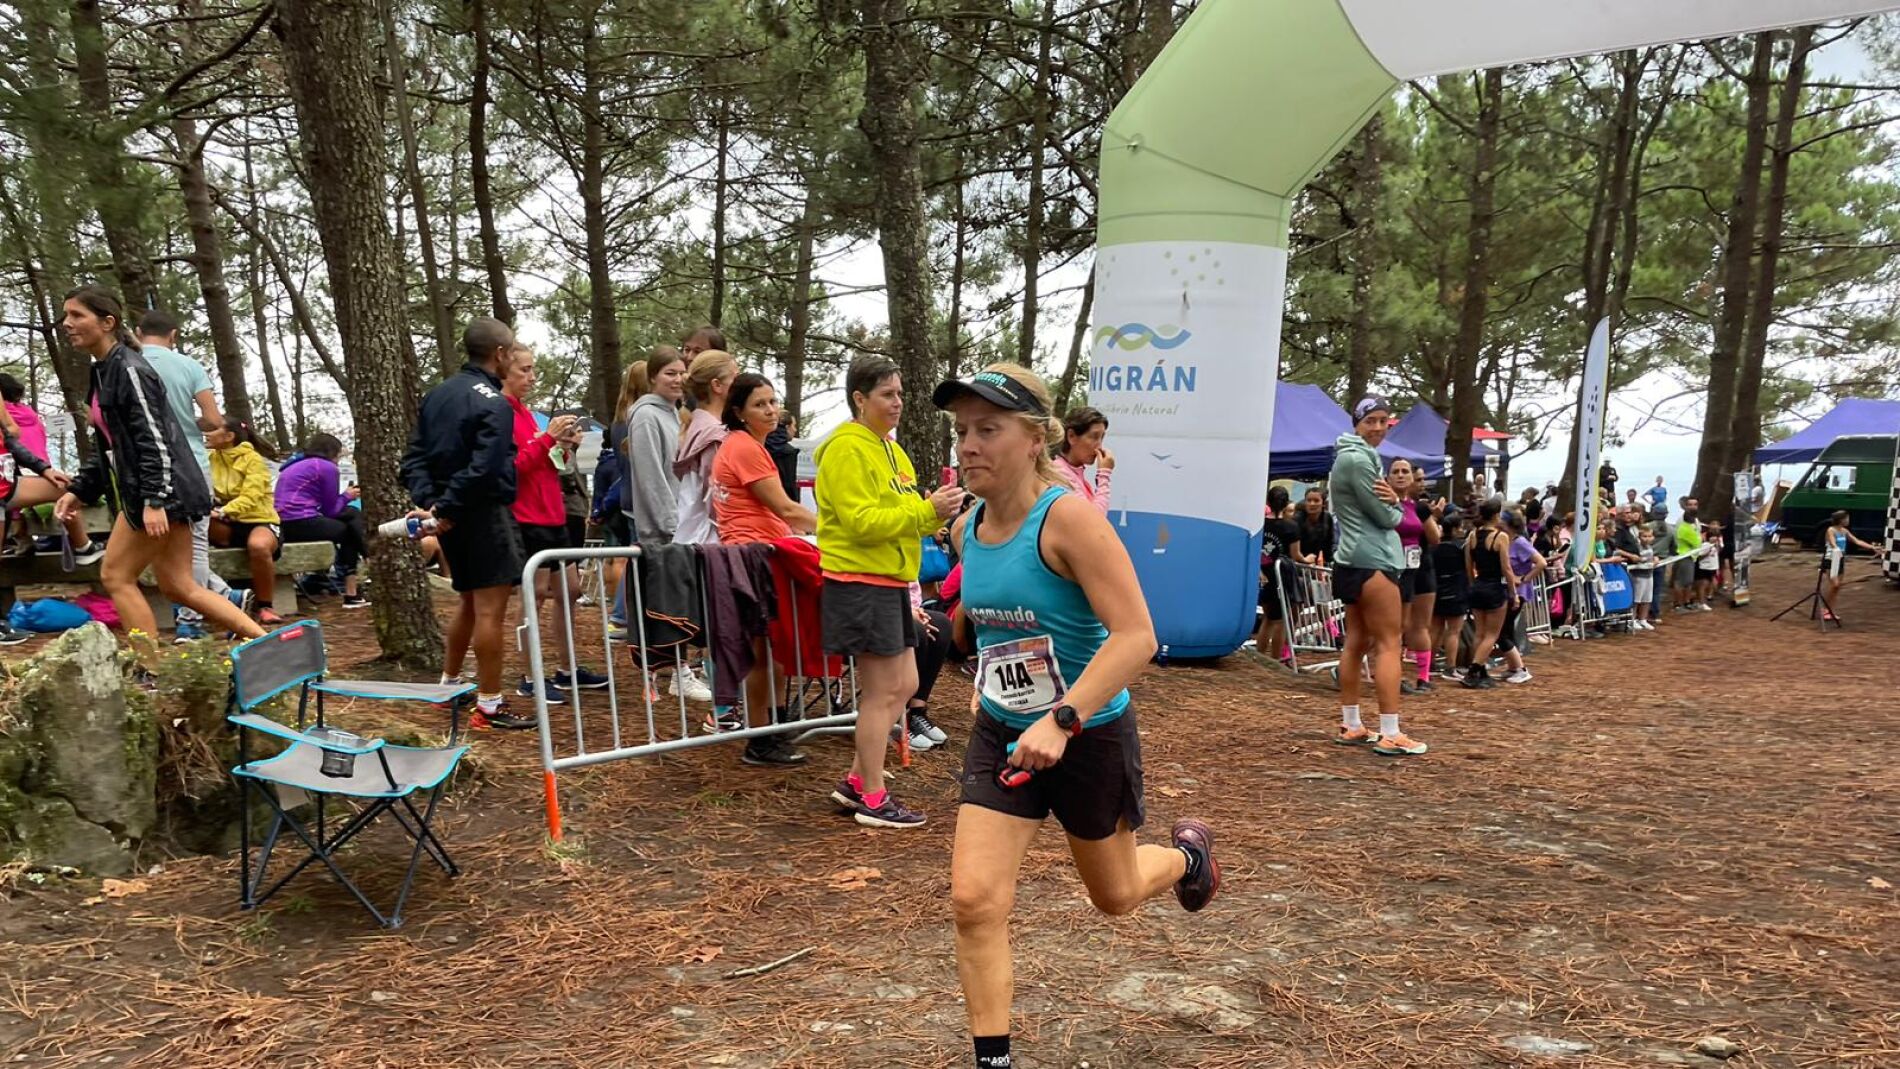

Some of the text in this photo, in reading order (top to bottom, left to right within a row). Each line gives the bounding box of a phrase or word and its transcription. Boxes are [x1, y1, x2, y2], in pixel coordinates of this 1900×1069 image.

[1089, 359, 1197, 392] NIGRÁN
[1131, 403, 1180, 416] Natural
[995, 662, 1034, 692] 14A
